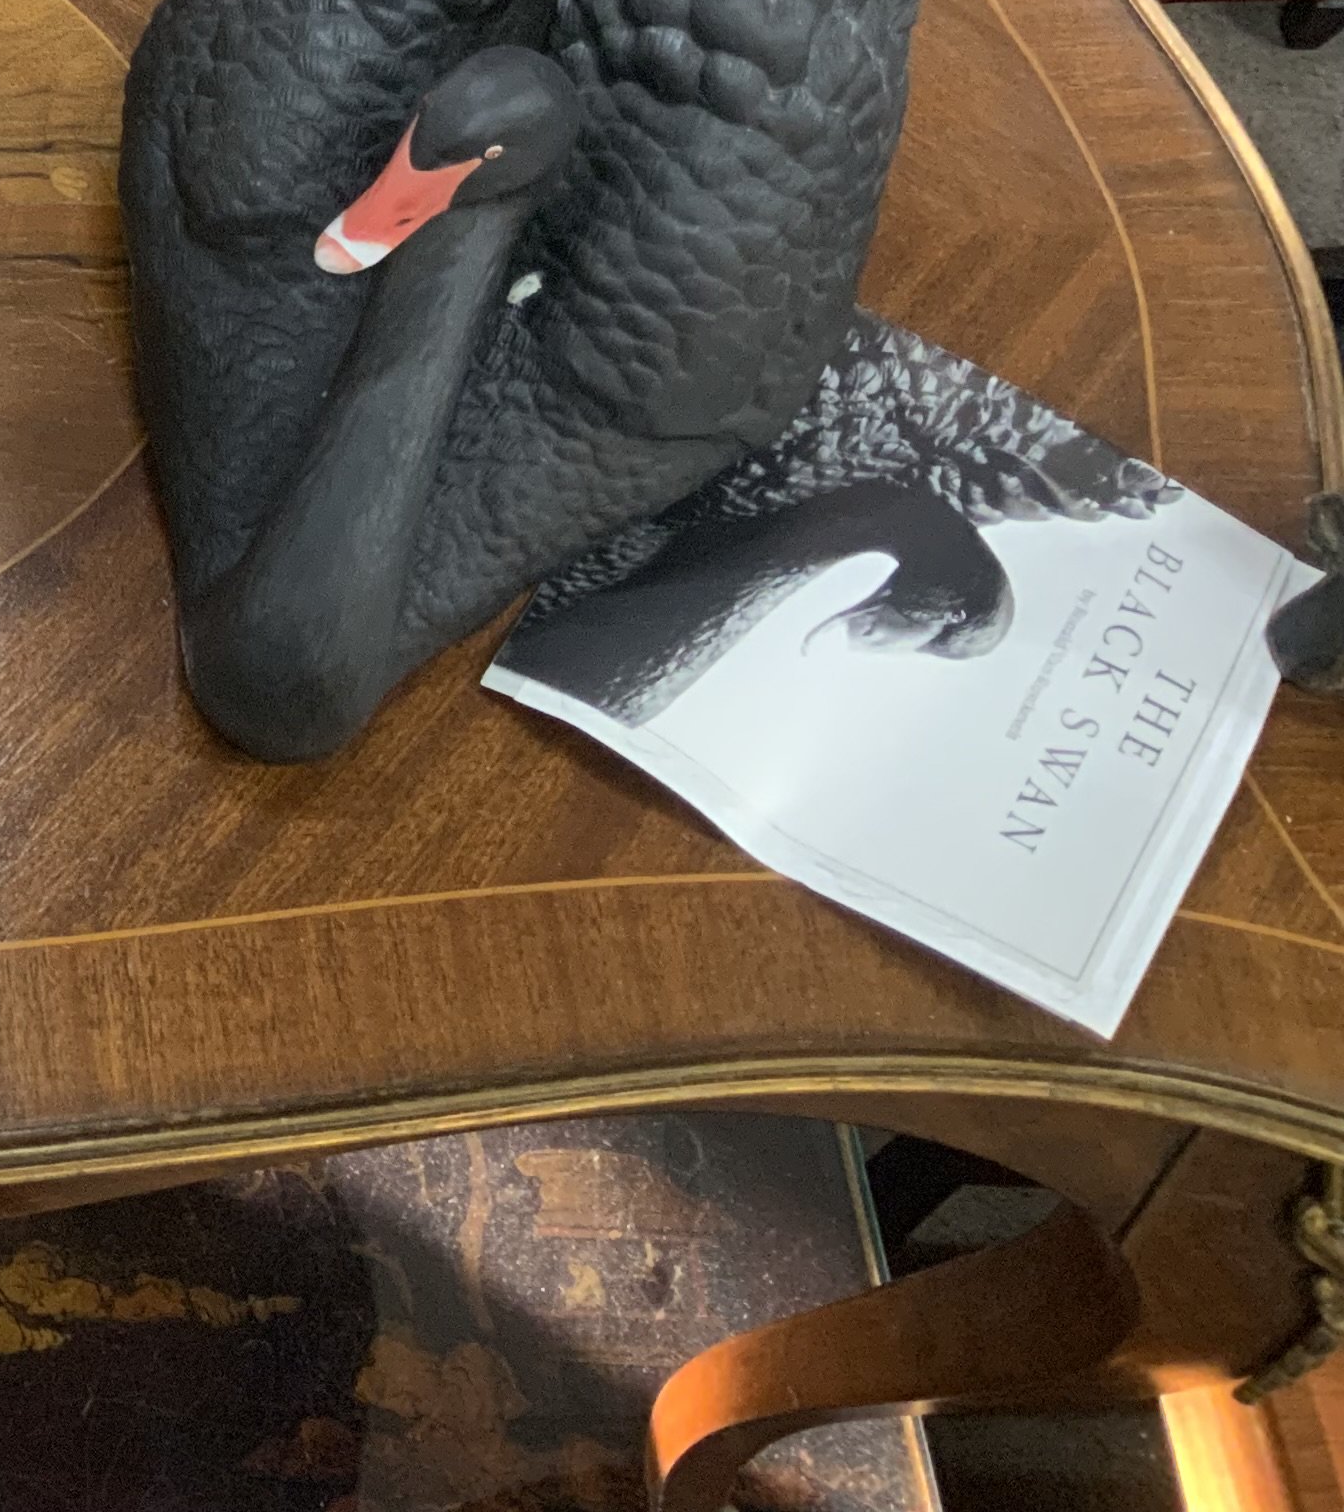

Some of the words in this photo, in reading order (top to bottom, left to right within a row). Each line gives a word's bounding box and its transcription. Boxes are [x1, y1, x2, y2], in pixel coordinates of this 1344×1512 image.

[1082, 541, 1183, 693] BLACK
[999, 707, 1100, 854] SWAN
[1117, 668, 1198, 767] THE
